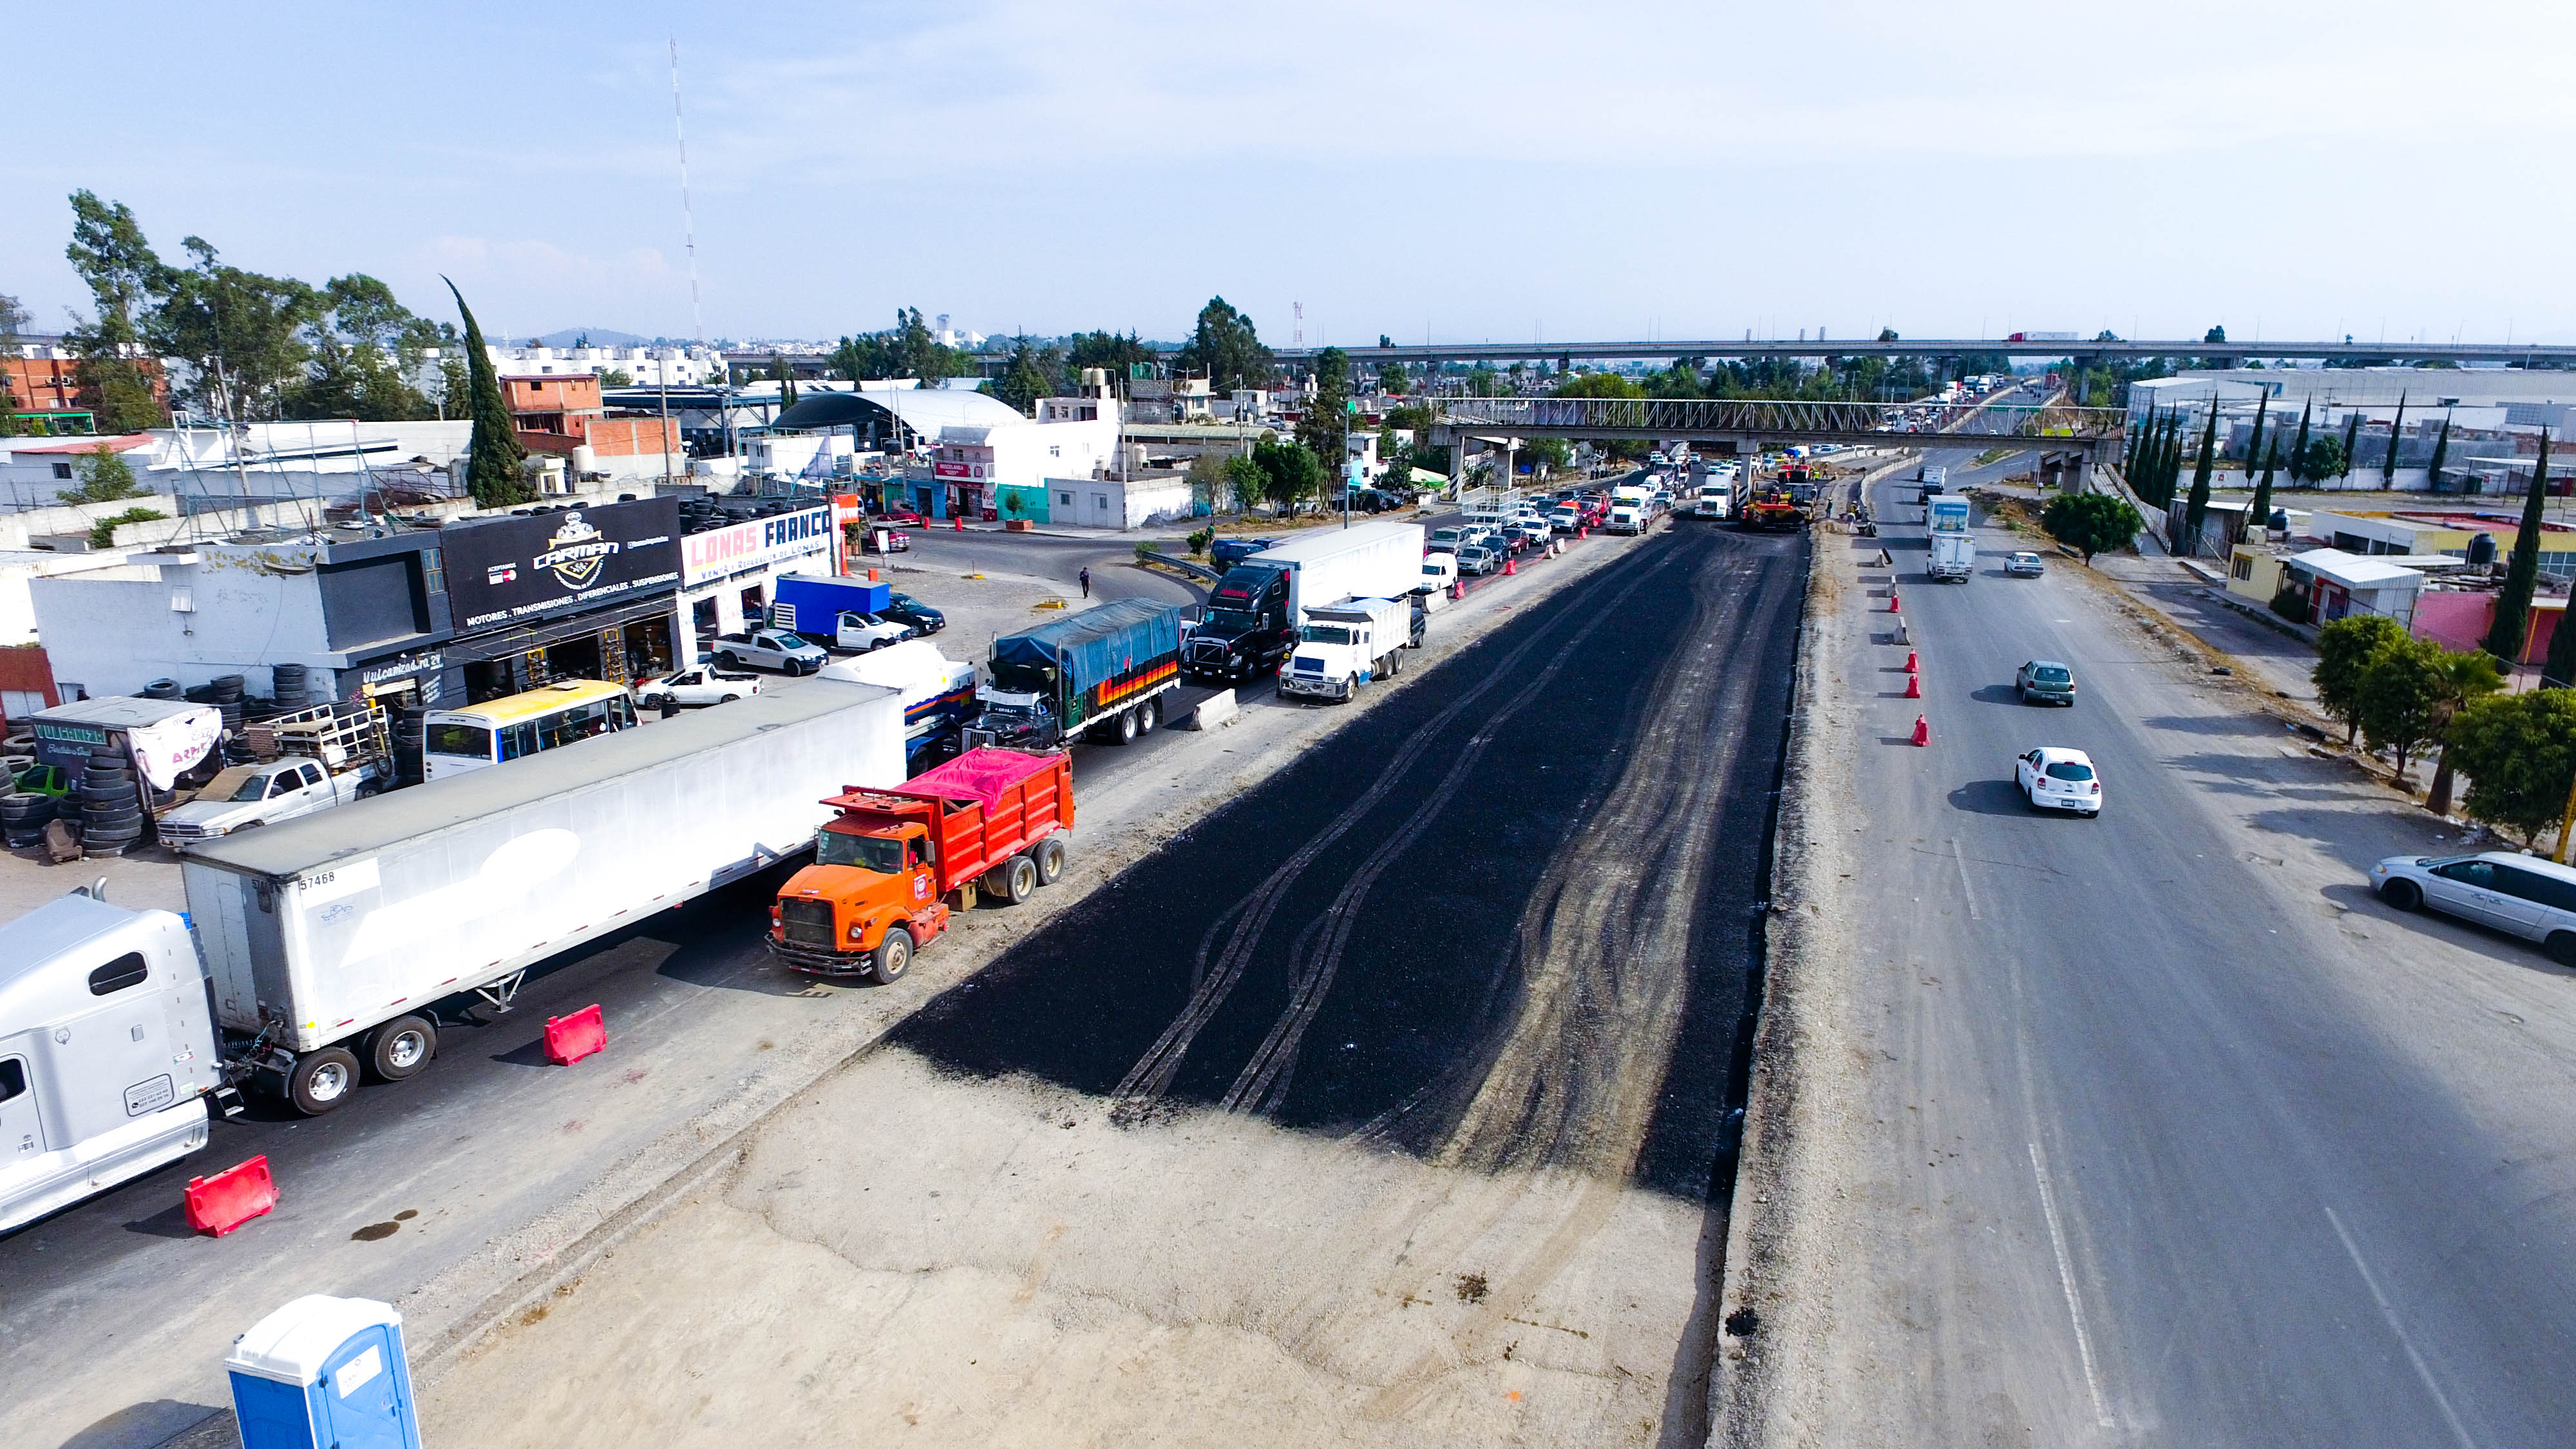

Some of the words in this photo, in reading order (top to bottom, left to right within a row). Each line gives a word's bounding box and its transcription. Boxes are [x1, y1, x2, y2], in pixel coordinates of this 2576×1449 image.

[691, 526, 757, 567] LONAS
[765, 509, 831, 548] FRANCO
[488, 562, 516, 573] ACEPTAMOS
[533, 542, 620, 570] CARMAN
[701, 564, 729, 580] VENTA
[780, 549, 788, 558] DE
[791, 541, 820, 554] LONAS
[467, 610, 507, 627] MOTORES
[511, 595, 573, 617] TRANSMISIONES
[578, 582, 629, 601] DIFERENCIALES
[632, 571, 679, 589] SUSPENSIONES
[300, 871, 336, 891] 57468
